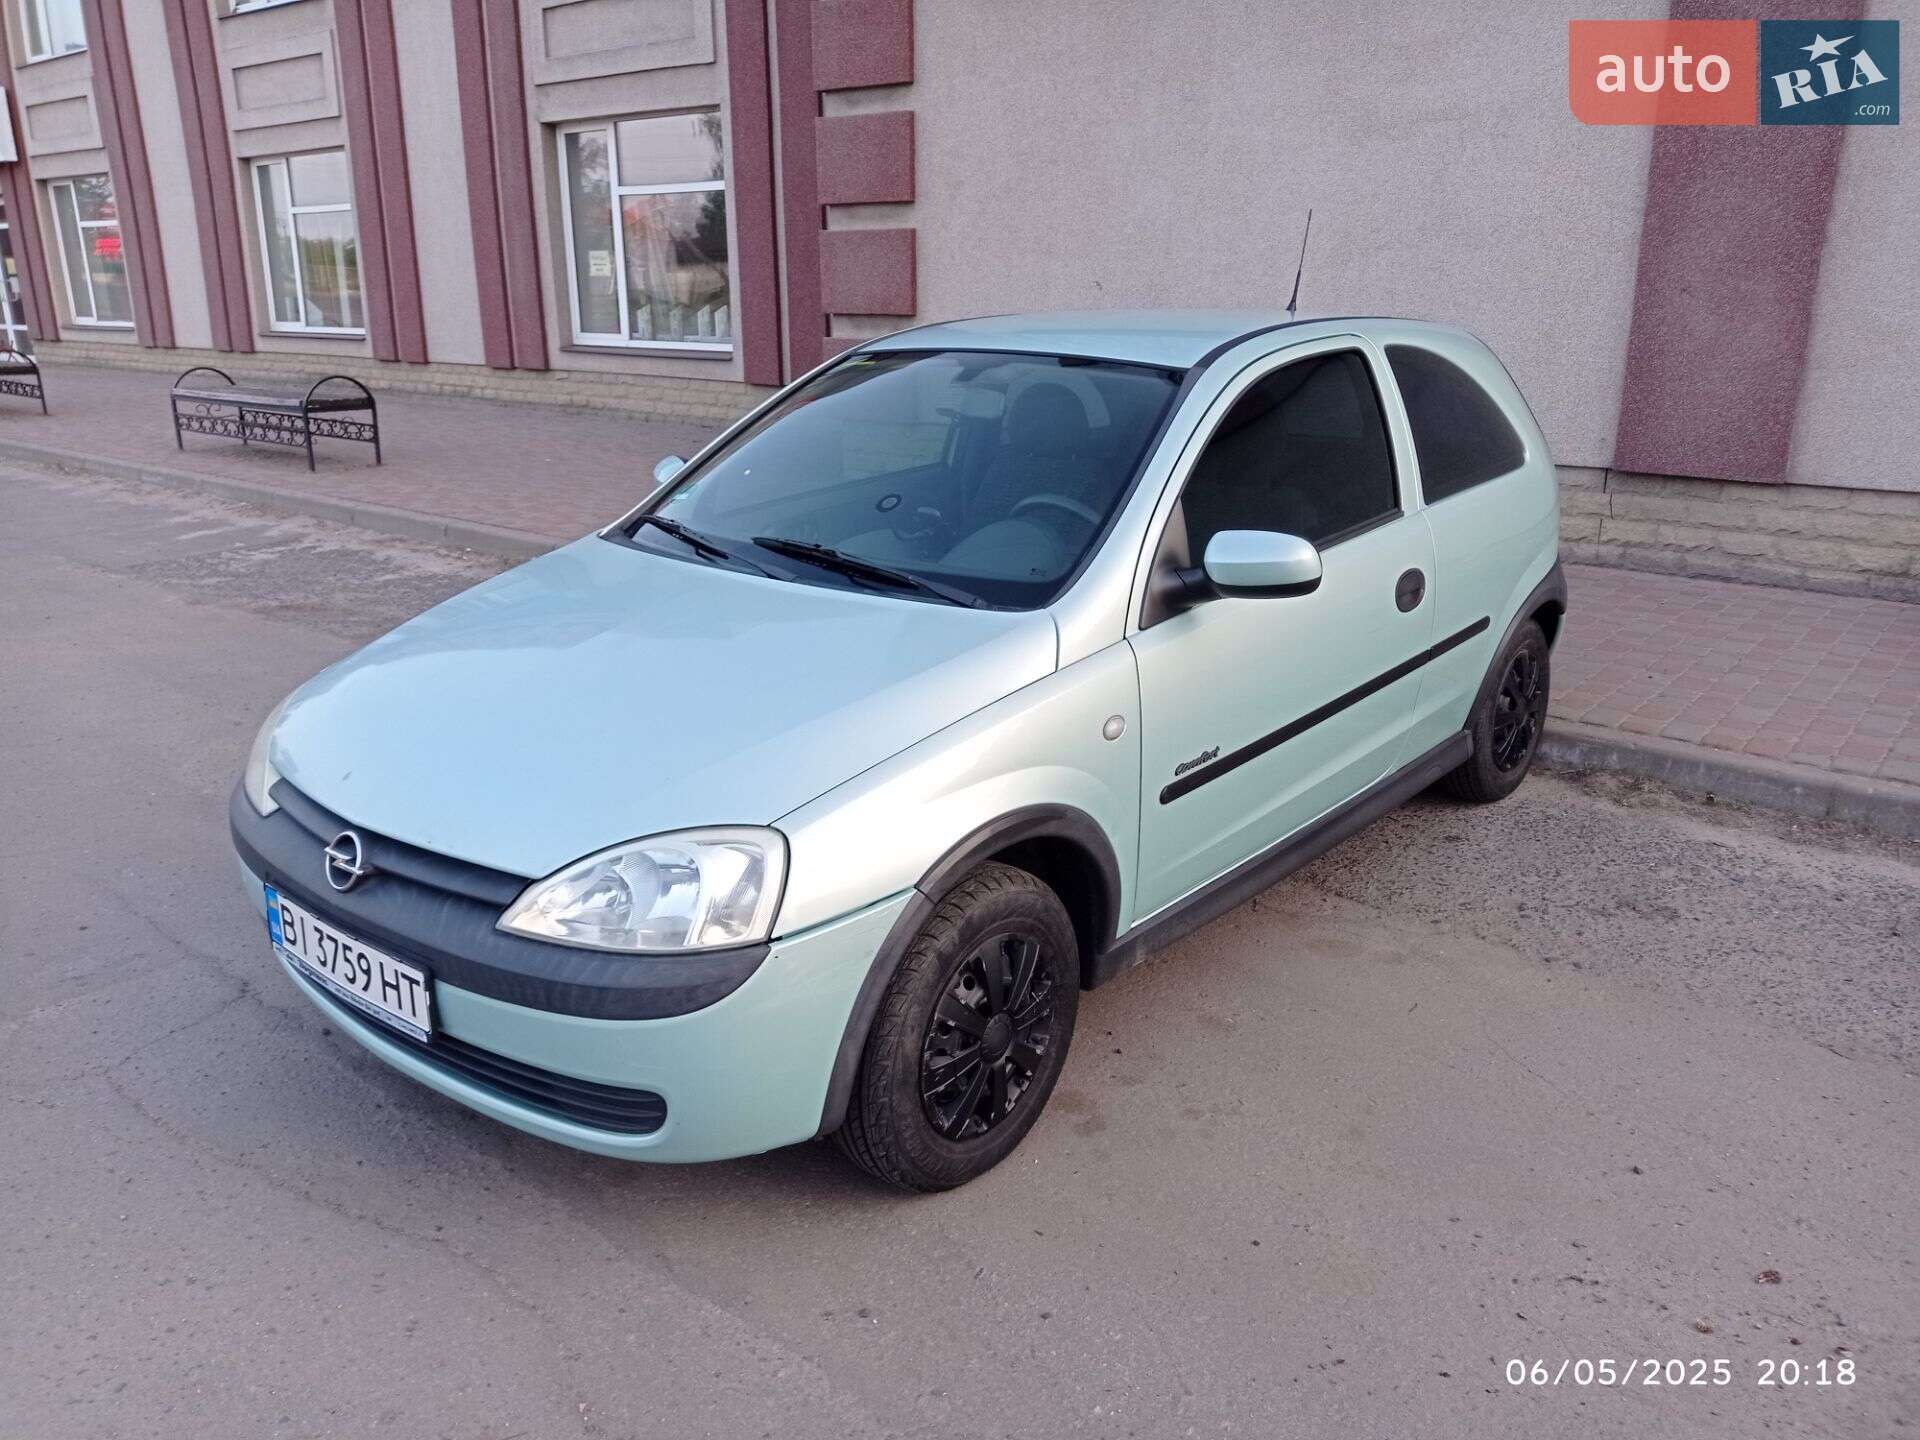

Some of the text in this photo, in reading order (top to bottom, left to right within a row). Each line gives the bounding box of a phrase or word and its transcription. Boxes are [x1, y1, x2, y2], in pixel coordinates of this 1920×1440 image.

[280, 903, 308, 956] BI
[313, 924, 372, 992] 3759
[379, 961, 421, 1018] HT
